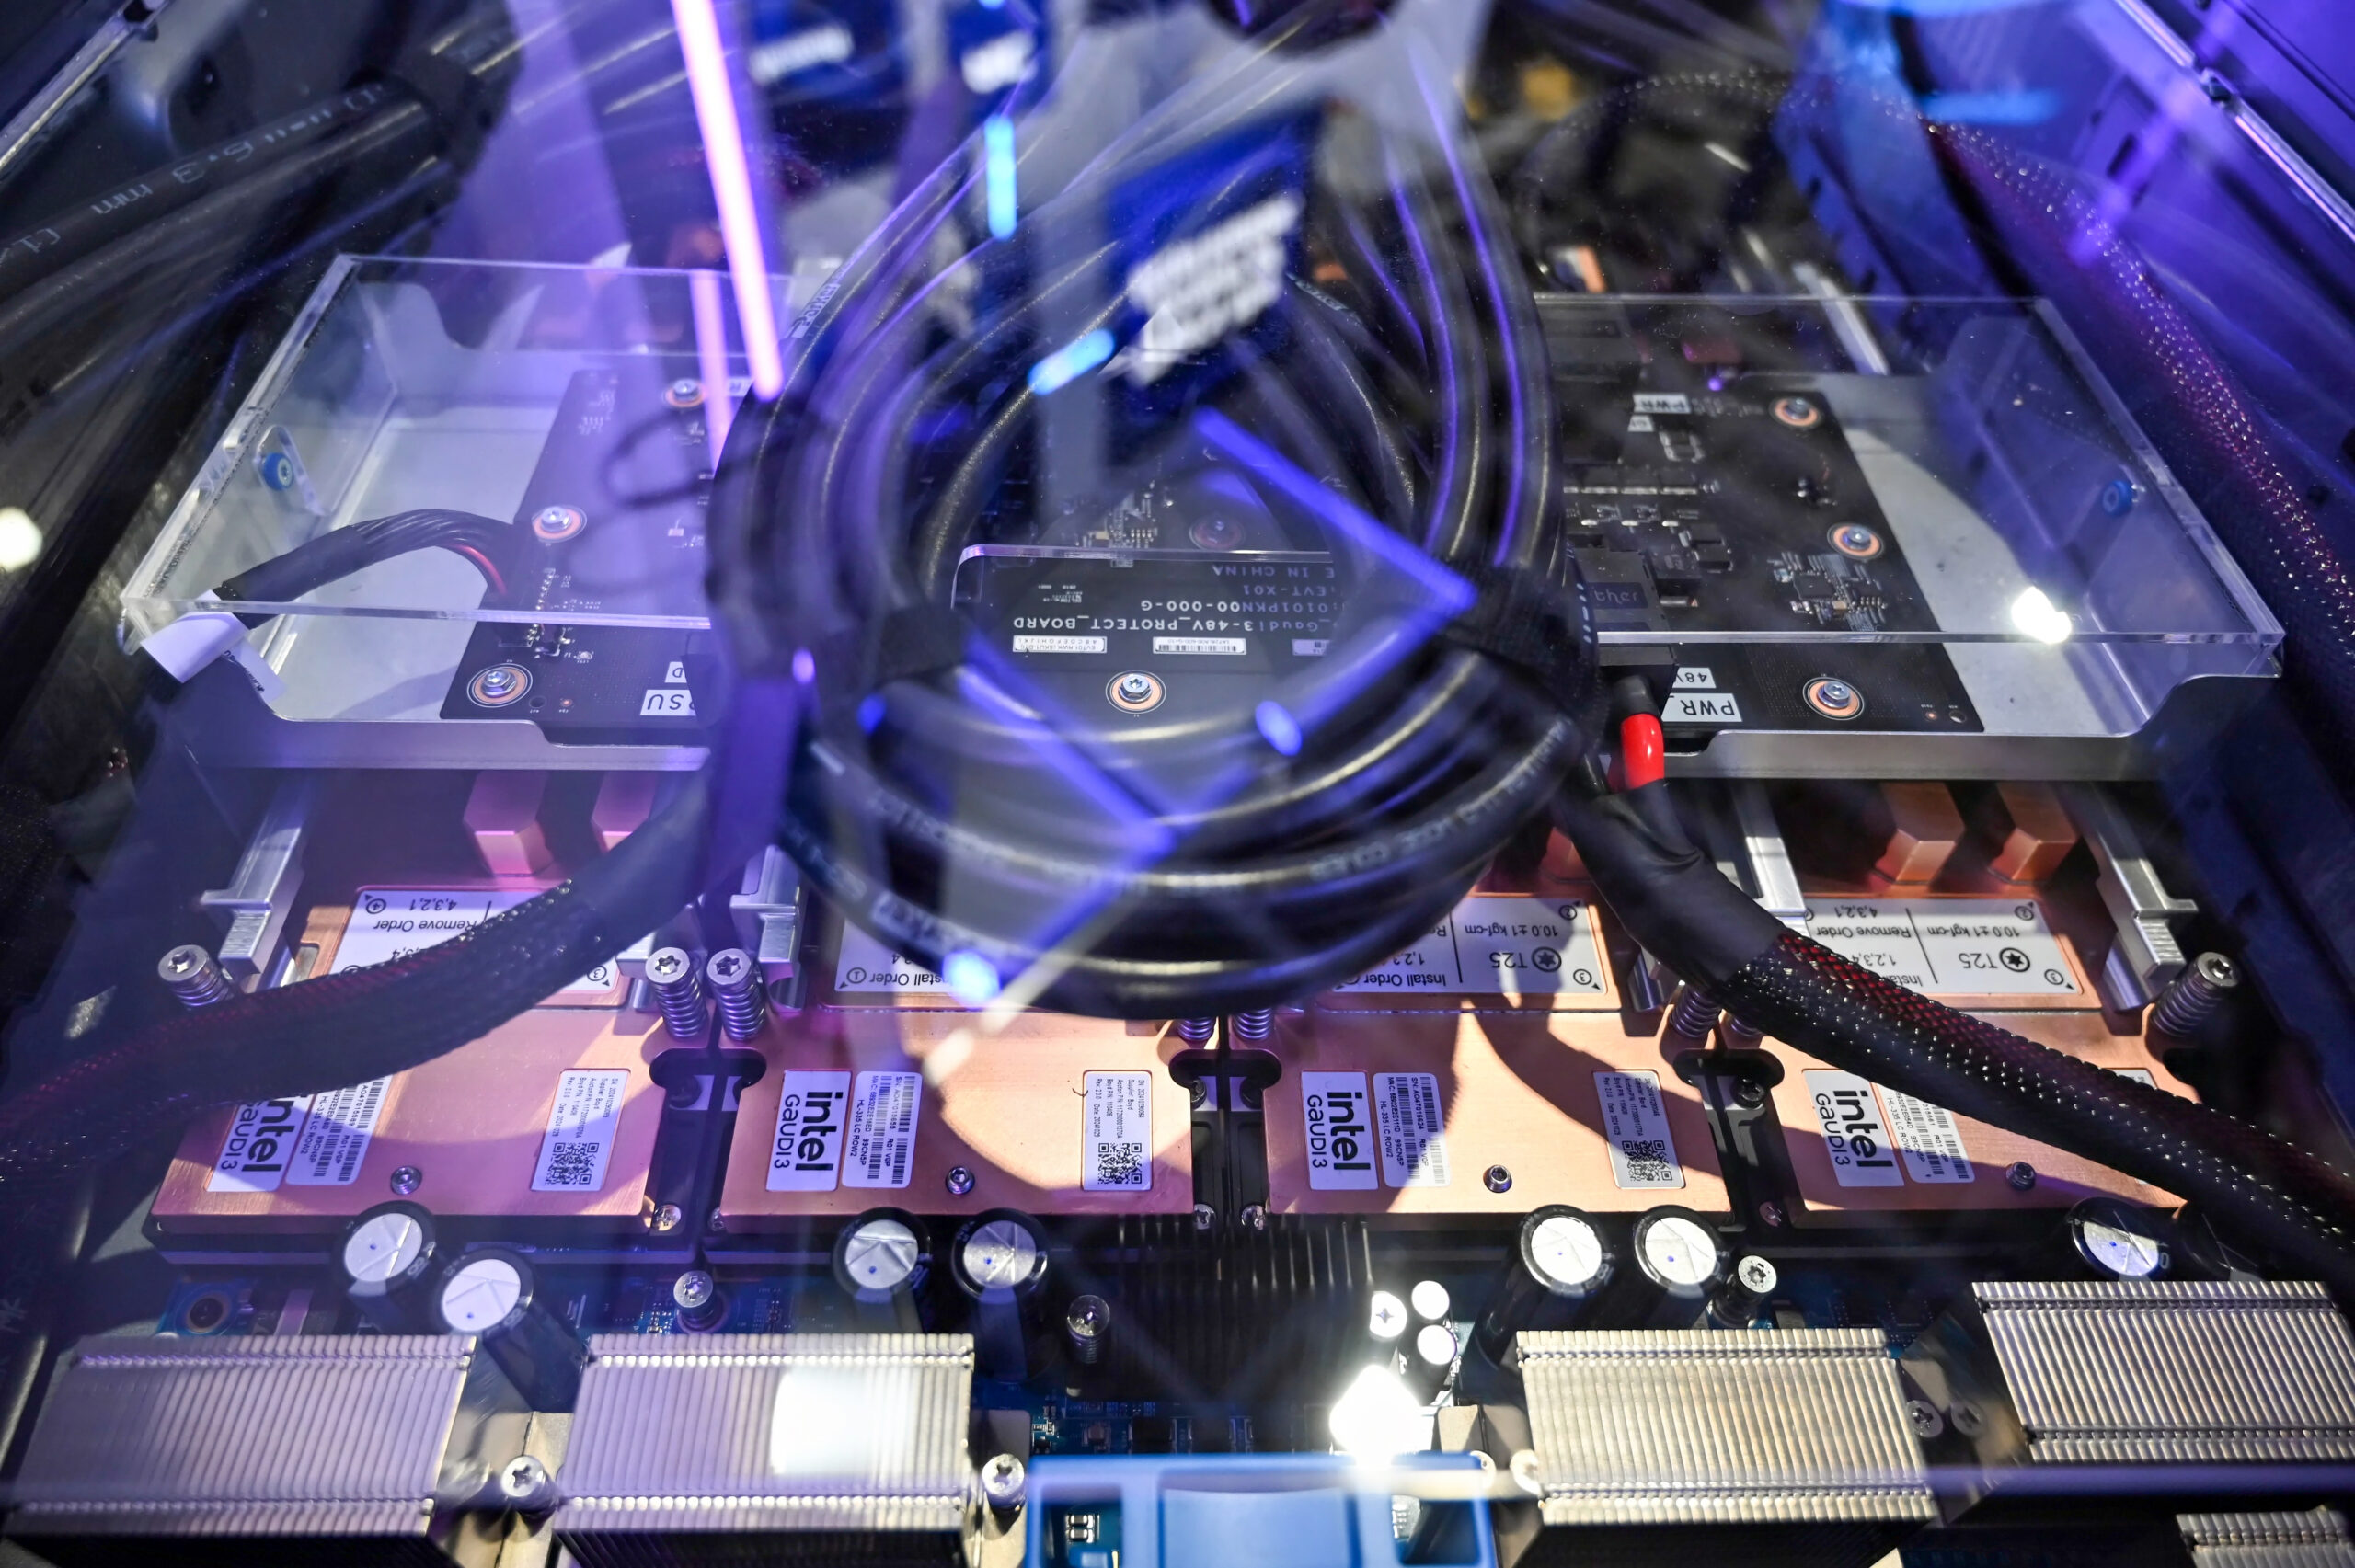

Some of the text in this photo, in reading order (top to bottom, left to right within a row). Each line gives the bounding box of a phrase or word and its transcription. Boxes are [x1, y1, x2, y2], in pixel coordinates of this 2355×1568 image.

[1212, 564, 1274, 578] CHINA
[1287, 567, 1310, 578] IN
[409, 898, 457, 912] 4,3,2,1
[1833, 905, 1878, 919] 4,3,2,1
[373, 920, 477, 933] Remove Order
[1464, 921, 1507, 937] kgf-cm
[1532, 924, 1559, 937] 10.0
[1815, 926, 1912, 939] Remove Order
[1926, 923, 1970, 939] kgf-cm
[1993, 925, 2021, 939] 10.0
[1488, 951, 1529, 969] T25
[1958, 952, 1998, 970] T25
[870, 973, 946, 987] stall Order
[1363, 973, 1446, 987] Install Order
[1881, 974, 1923, 987] Insta
[1380, 1100, 1392, 1123] HL-335
[795, 1091, 844, 1171] intel
[853, 1124, 862, 1134] LC
[1327, 1091, 1372, 1171] intel
[1383, 1124, 1391, 1134] LC
[1832, 1090, 1894, 1168] intel
[1895, 1121, 1905, 1131] LC
[241, 1100, 295, 1172] ntel
[220, 1160, 238, 1170] 3
[774, 1158, 791, 1169] 3
[1312, 1158, 1328, 1169] 3
[1834, 1156, 1851, 1166] 3
